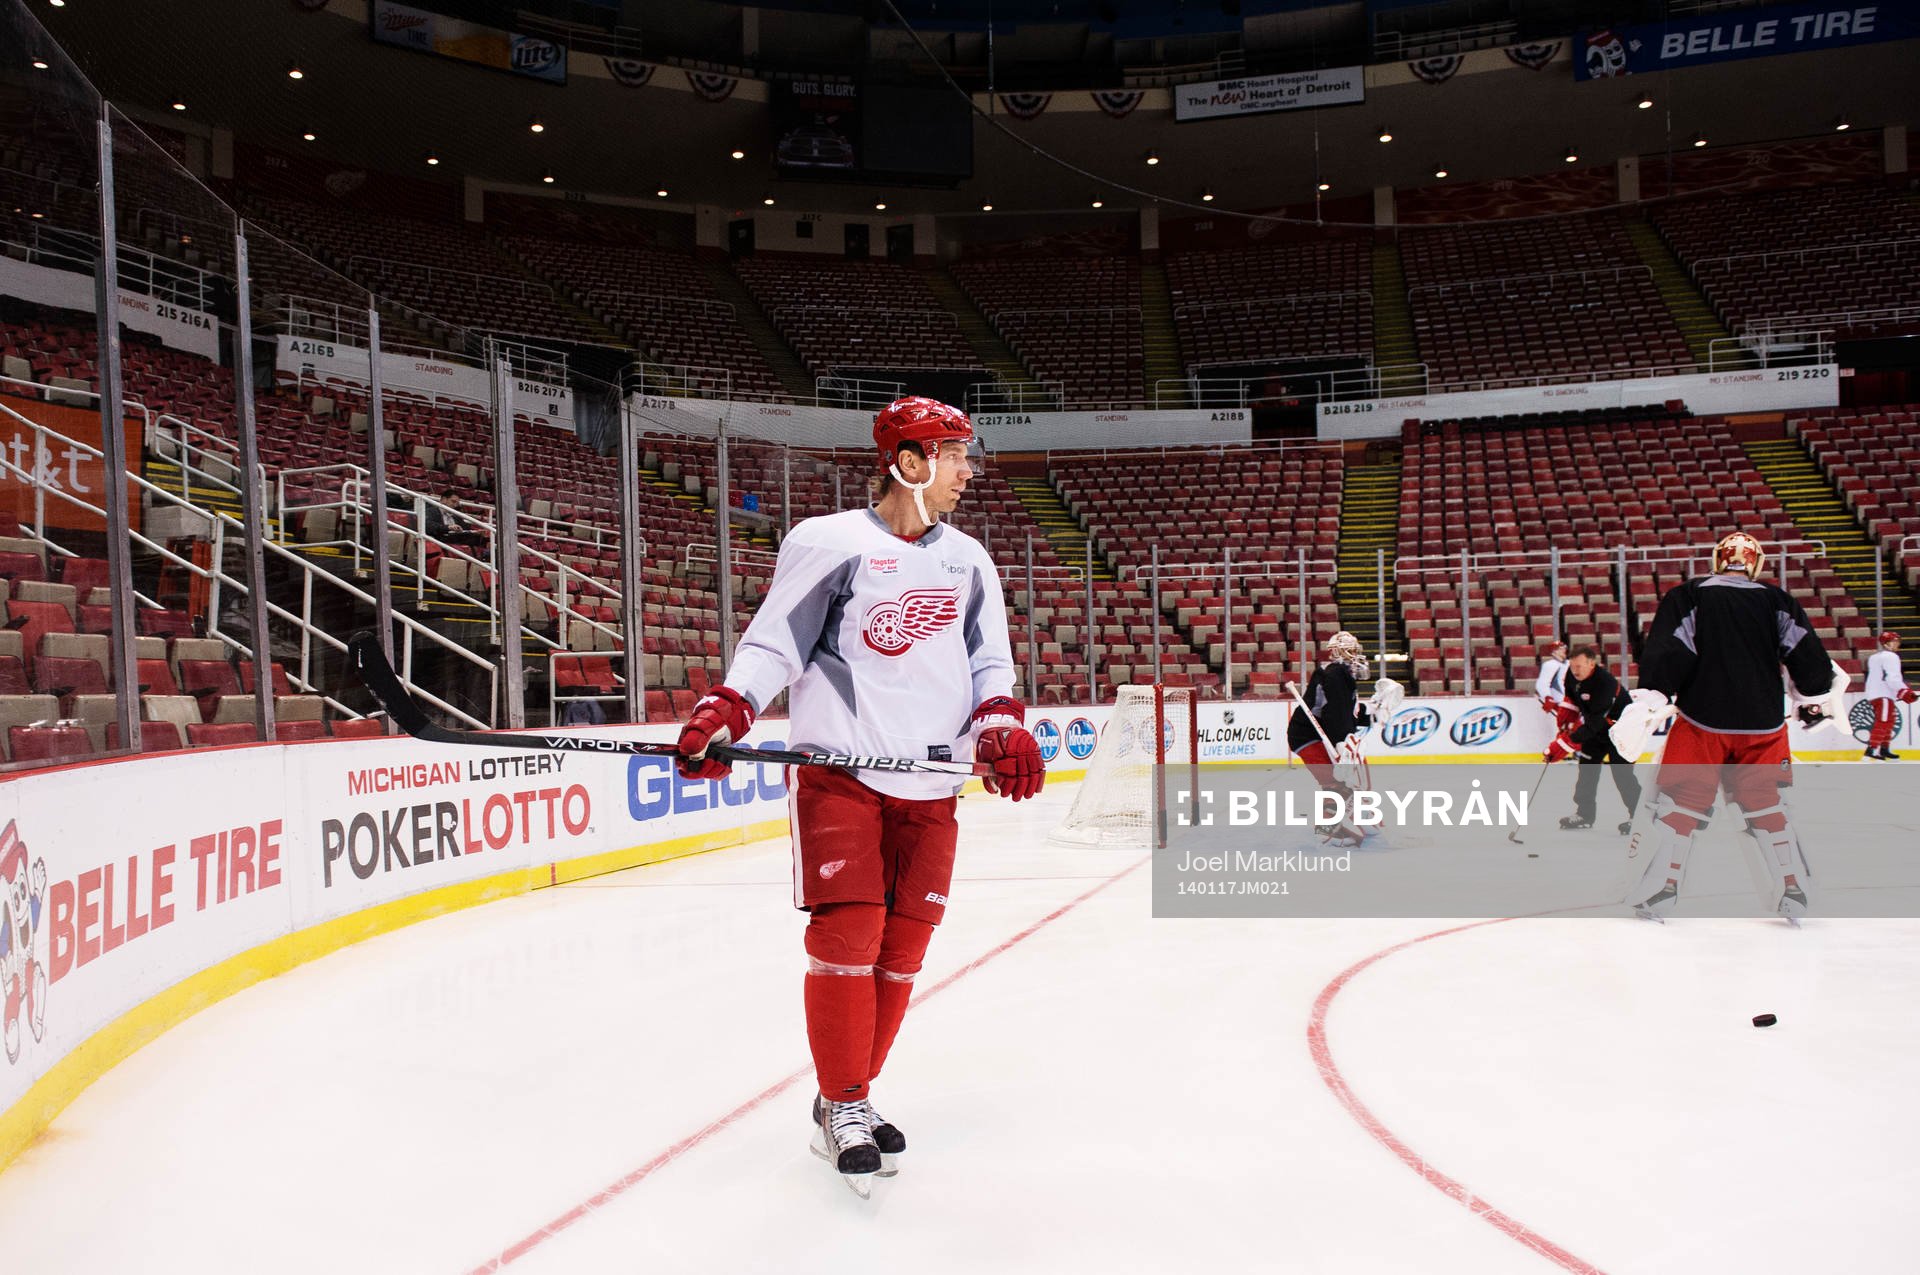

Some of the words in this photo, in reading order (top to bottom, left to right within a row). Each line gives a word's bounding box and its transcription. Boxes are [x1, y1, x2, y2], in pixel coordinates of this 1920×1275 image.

[1660, 19, 1779, 59] BELLE
[1790, 7, 1878, 42] TIRE
[824, 83, 856, 97] GLORY.
[1247, 79, 1274, 89] Heart
[1277, 73, 1318, 86] Hospital
[1188, 97, 1207, 106] The
[1210, 90, 1246, 106] new
[1250, 89, 1283, 100] Heart
[1288, 86, 1301, 96] of
[1306, 81, 1350, 94] Detroit
[117, 294, 149, 312] TANDING
[156, 304, 177, 320] 215
[415, 363, 453, 376] STANDING
[1723, 374, 1763, 383] STANDING
[1778, 371, 1799, 381] 219
[1803, 368, 1829, 379] 220
[518, 382, 540, 394] B216
[542, 386, 557, 397] 217
[759, 407, 791, 416] STANDING
[1324, 405, 1351, 415] B218
[1354, 403, 1373, 413] 219
[978, 416, 1001, 425] C217
[1197, 727, 1271, 743] HL.COM/GCL
[1391, 714, 1433, 746] Lite
[1459, 713, 1503, 746] Lite
[544, 736, 640, 754] VAPOR
[1067, 723, 1095, 755] Kroger
[1203, 745, 1222, 756] LIVE
[1225, 744, 1256, 755] GAMES
[808, 752, 915, 771] BAUER
[348, 761, 460, 796] MICHIGAN
[469, 753, 566, 781] LOTTERY
[628, 740, 788, 821] GEICO
[49, 844, 175, 986] BELLE
[190, 819, 282, 912] TIRE
